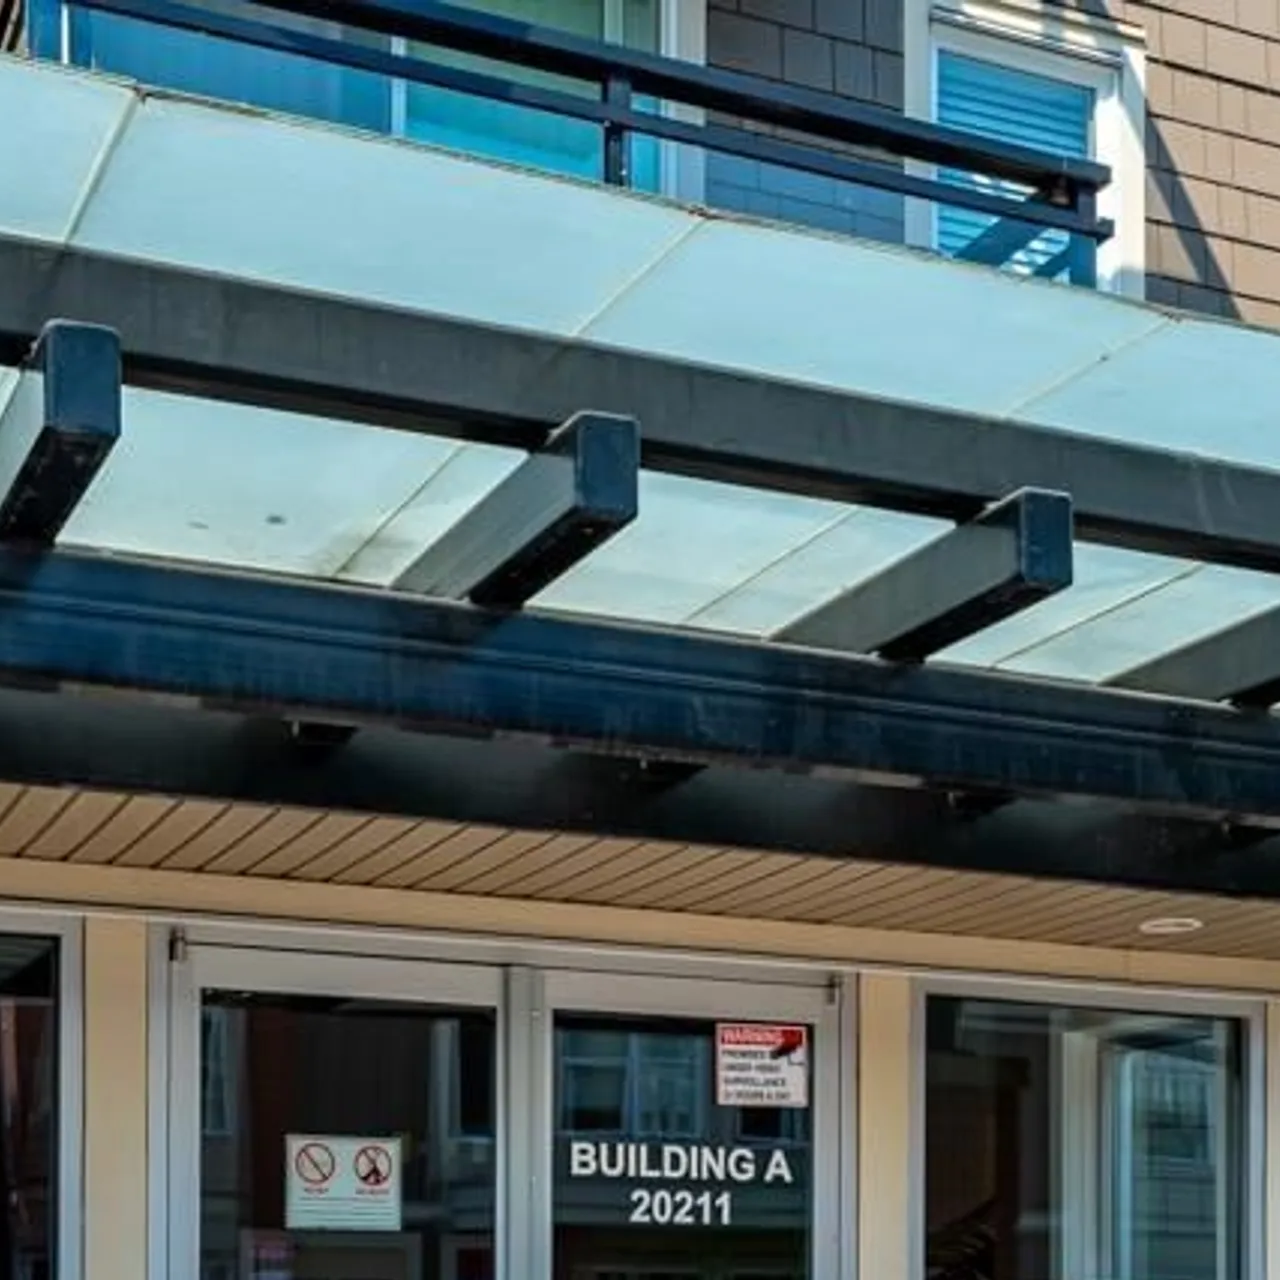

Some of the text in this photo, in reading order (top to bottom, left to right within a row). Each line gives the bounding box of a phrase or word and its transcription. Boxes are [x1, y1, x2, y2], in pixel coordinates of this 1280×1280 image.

[570, 1142, 793, 1183] BUILDING A
[629, 1189, 732, 1225] 20211
